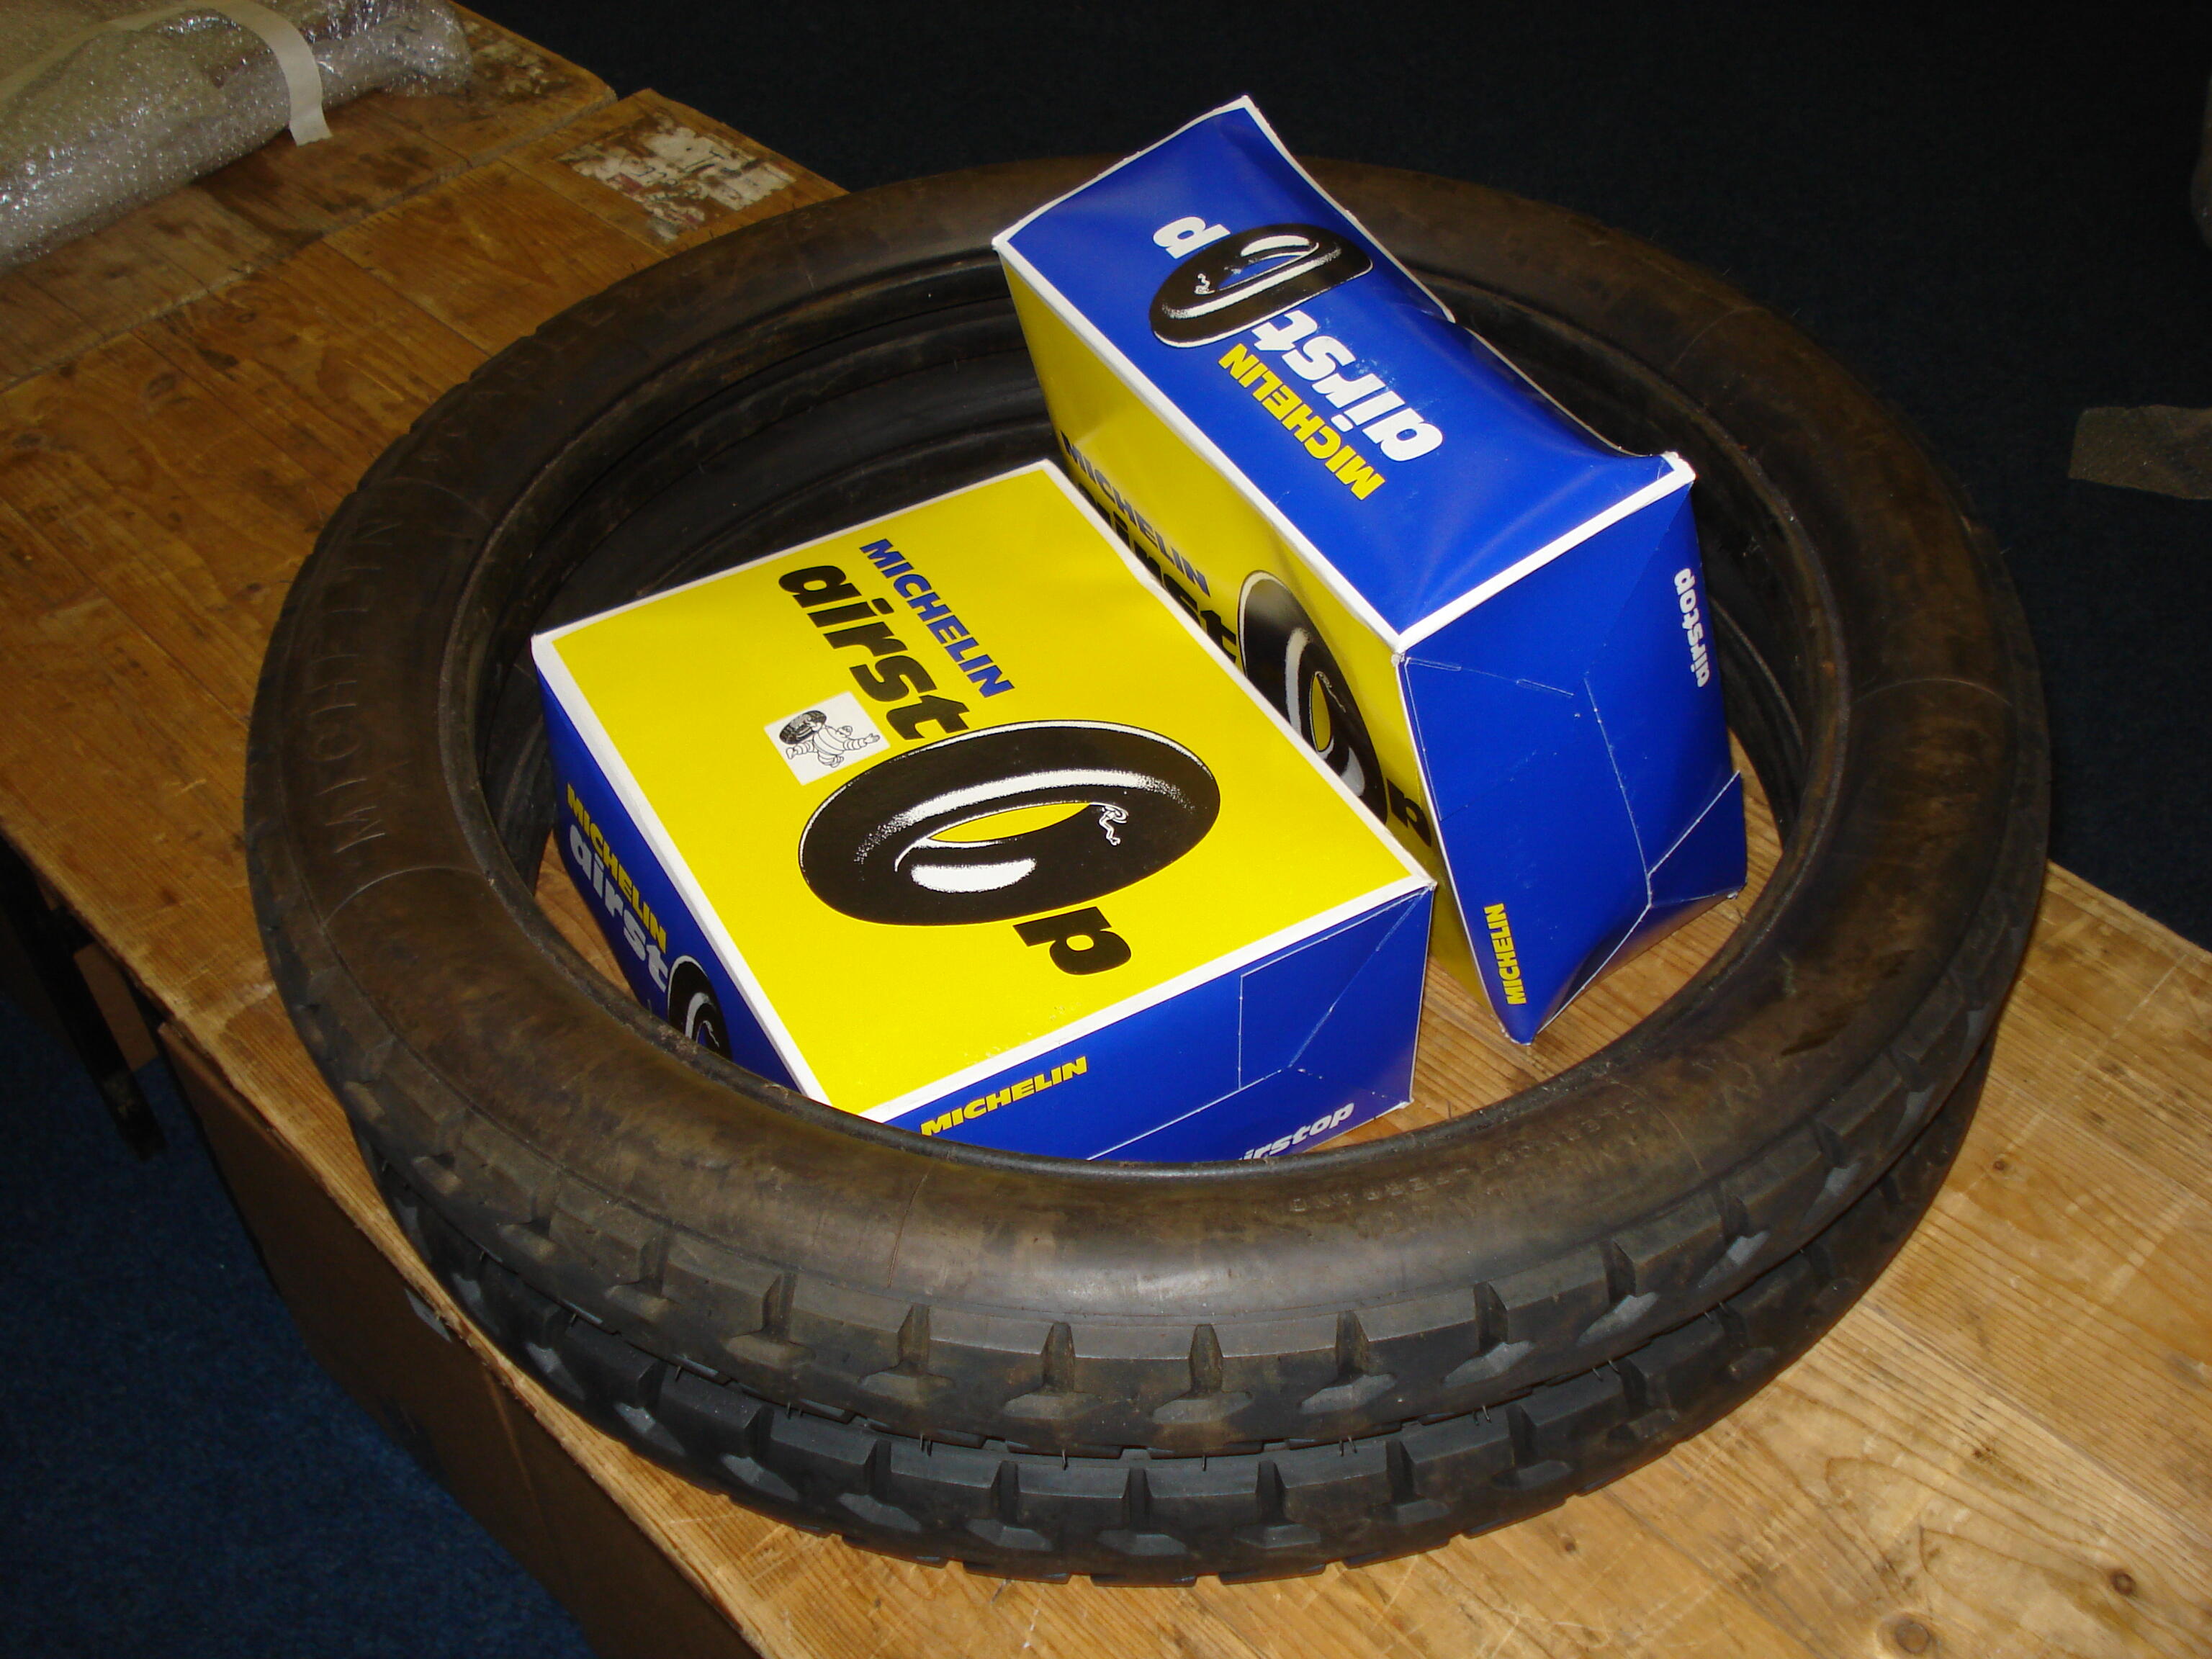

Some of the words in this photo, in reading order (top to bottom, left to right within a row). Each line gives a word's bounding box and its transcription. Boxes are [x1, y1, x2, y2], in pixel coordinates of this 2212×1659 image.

[1218, 343, 1385, 500] MICHELIN
[1060, 429, 1210, 598] MICHELIN
[858, 538, 1015, 698] MICHELIN
[1673, 567, 1710, 688] airstop
[567, 783, 666, 954] MICHELIN
[1484, 902, 1527, 1005] MICHELIN
[920, 1056, 1087, 1136] MICHELIN
[1238, 1102, 1355, 1161] irstop
